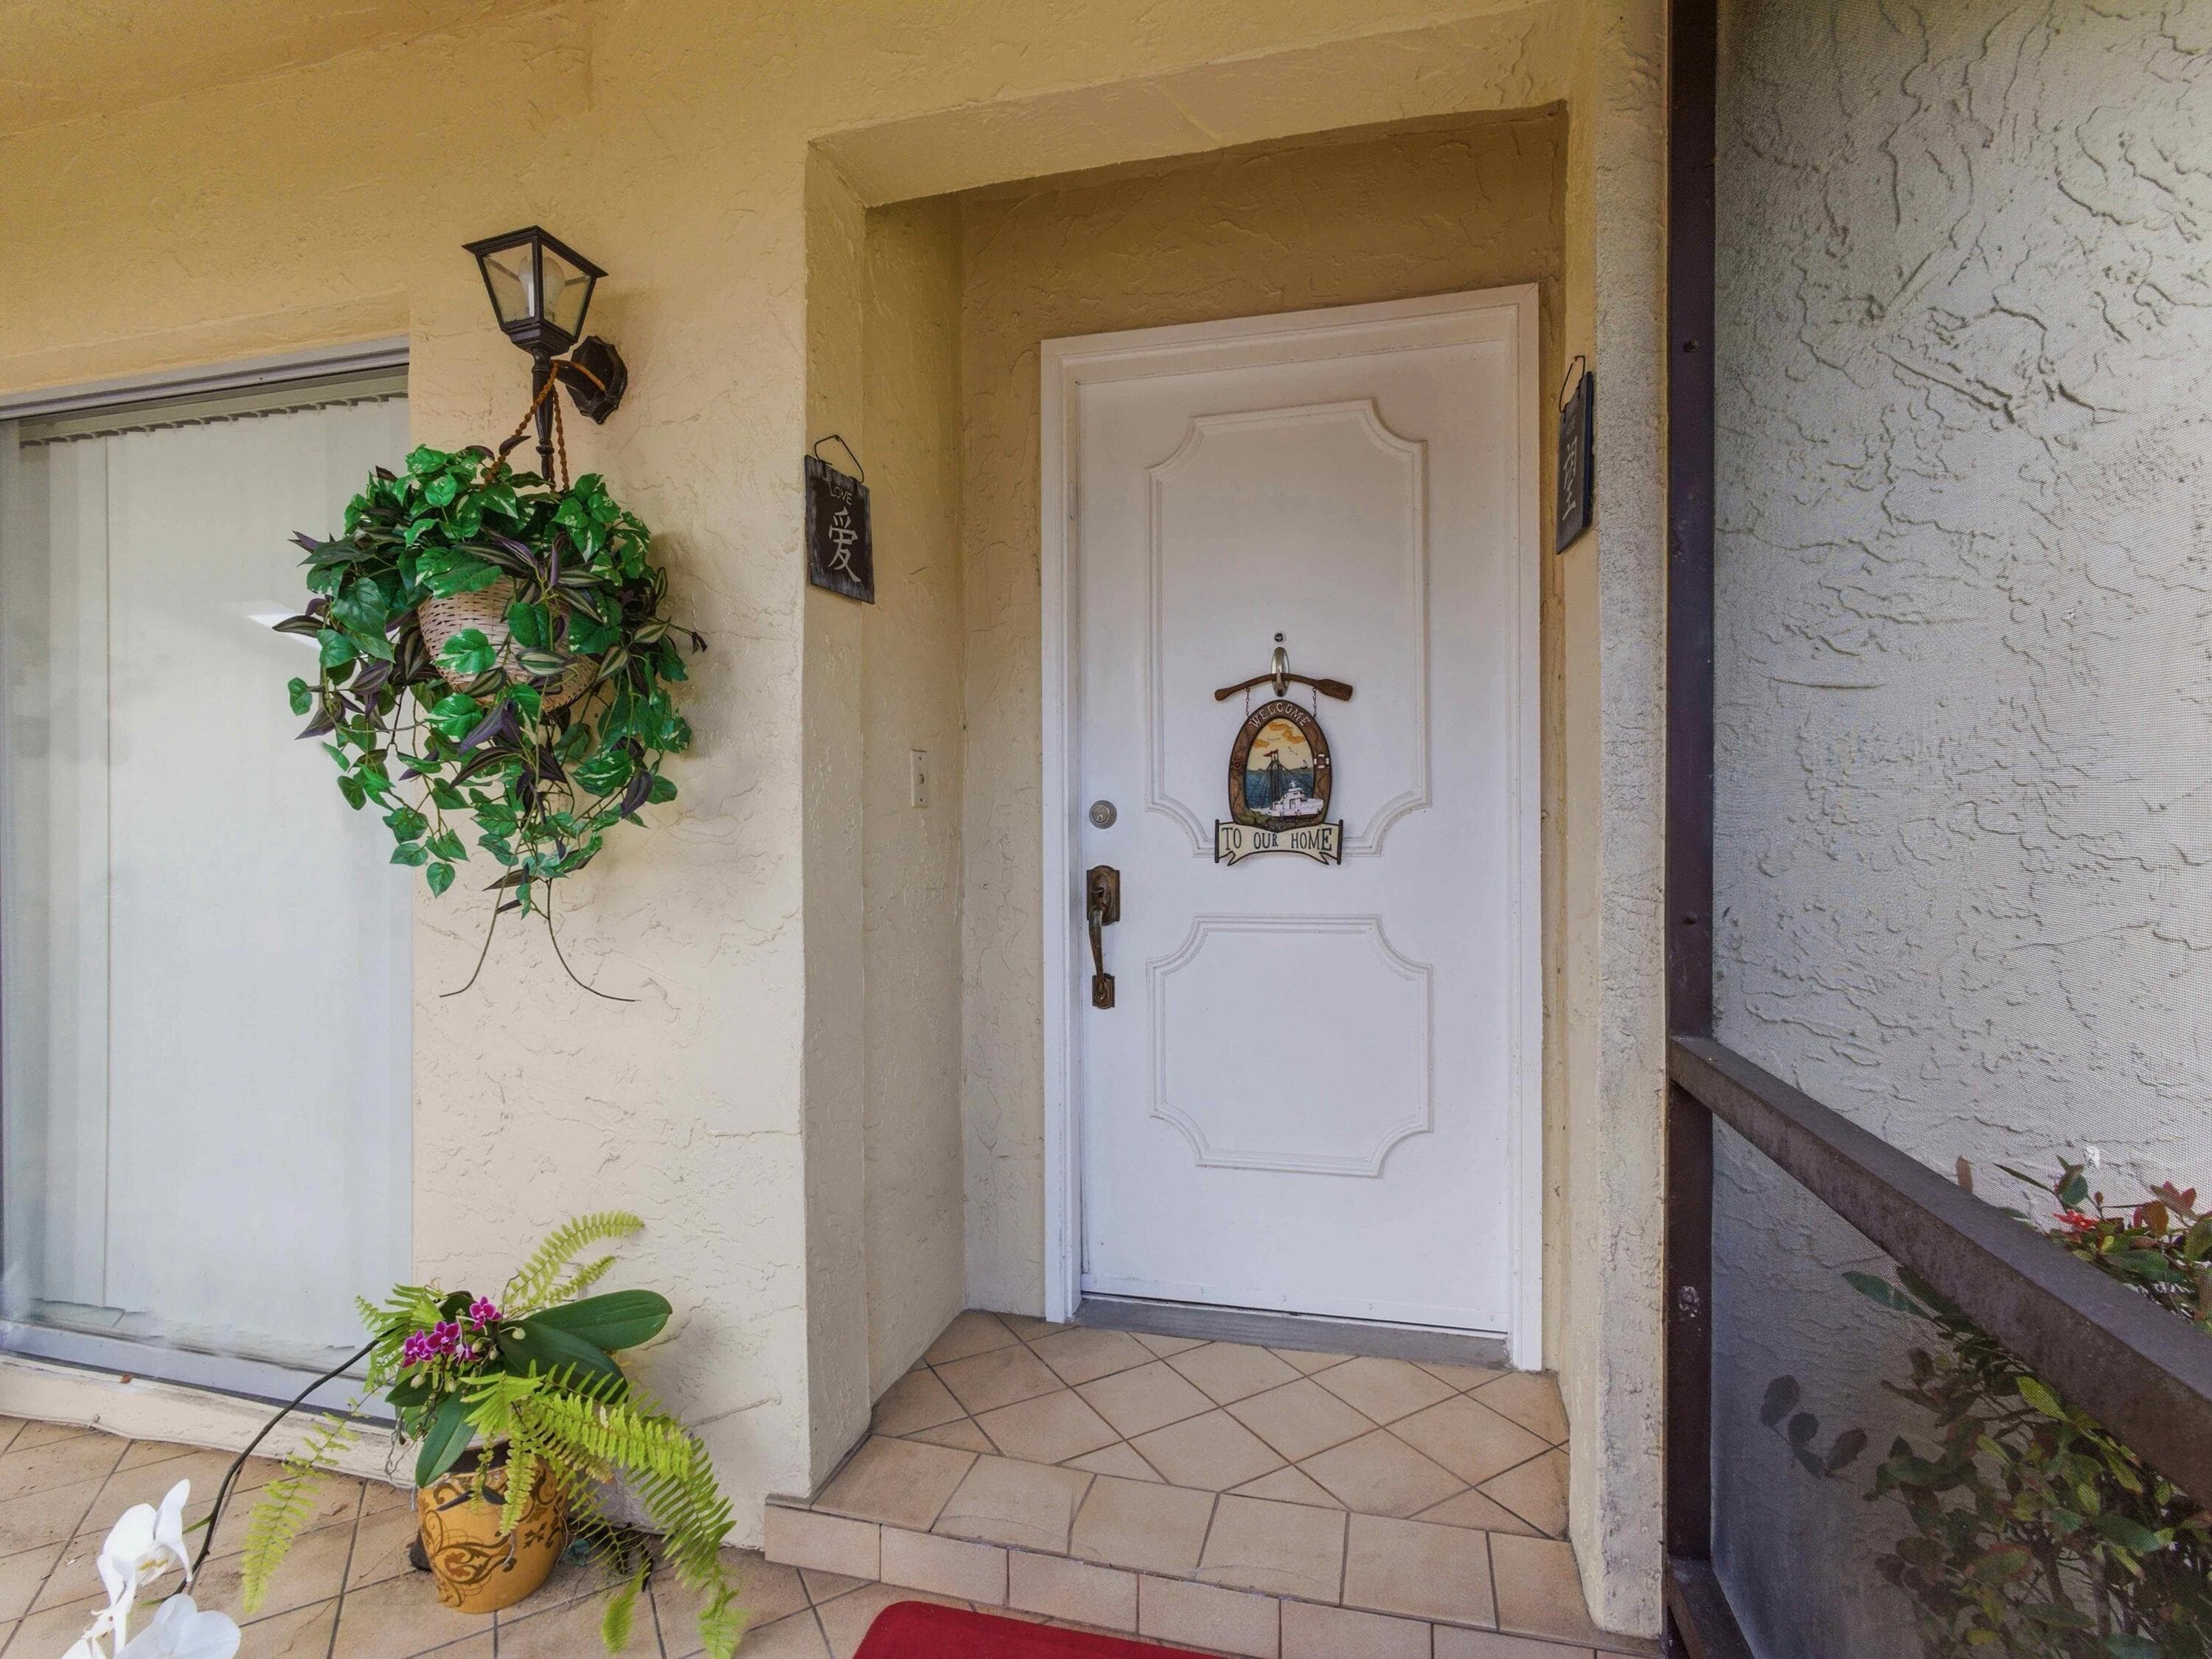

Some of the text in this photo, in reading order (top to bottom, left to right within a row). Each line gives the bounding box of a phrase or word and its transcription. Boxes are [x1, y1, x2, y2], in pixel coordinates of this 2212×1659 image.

[827, 482, 852, 505] LOVE
[828, 506, 861, 582] 爱
[1248, 702, 1310, 727] WELCOME
[1221, 827, 1332, 851] TO OUR HOME
